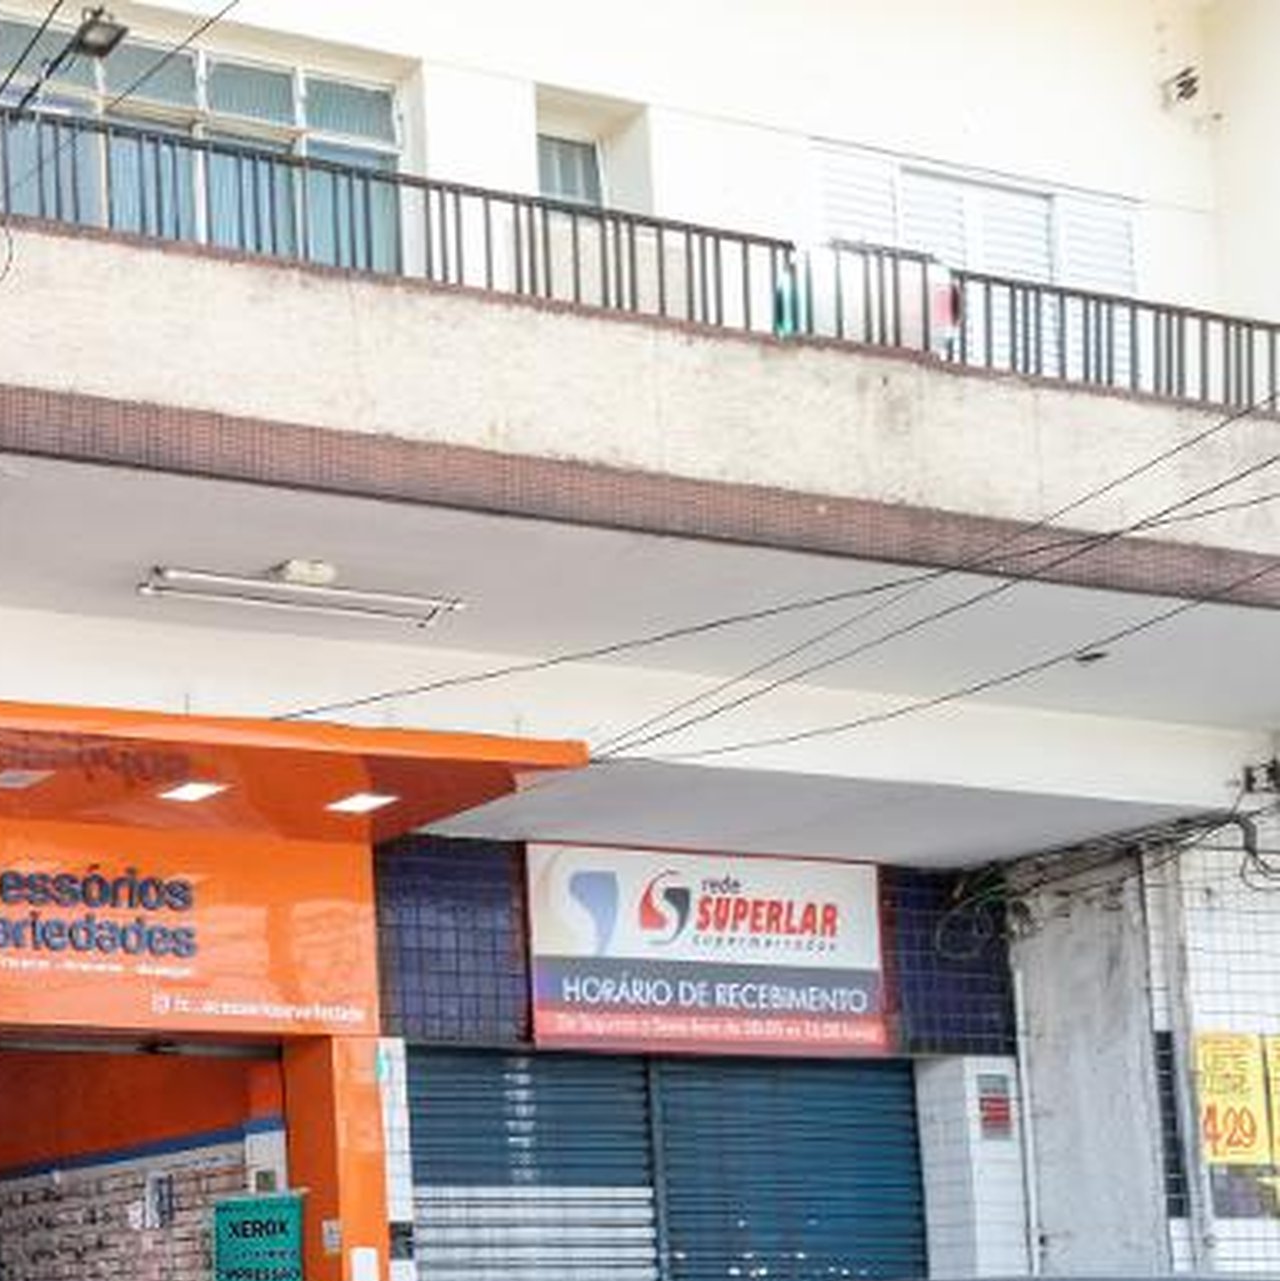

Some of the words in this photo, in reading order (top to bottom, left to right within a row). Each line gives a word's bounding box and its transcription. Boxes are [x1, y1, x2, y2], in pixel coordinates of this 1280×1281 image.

[702, 877, 740, 893] rede
[696, 896, 838, 936] SUPERLAR
[562, 972, 672, 1005] HORÁRIO
[677, 980, 710, 1006] DE
[715, 983, 869, 1012] RECEBIMENTO
[228, 1219, 290, 1238] XEROX
